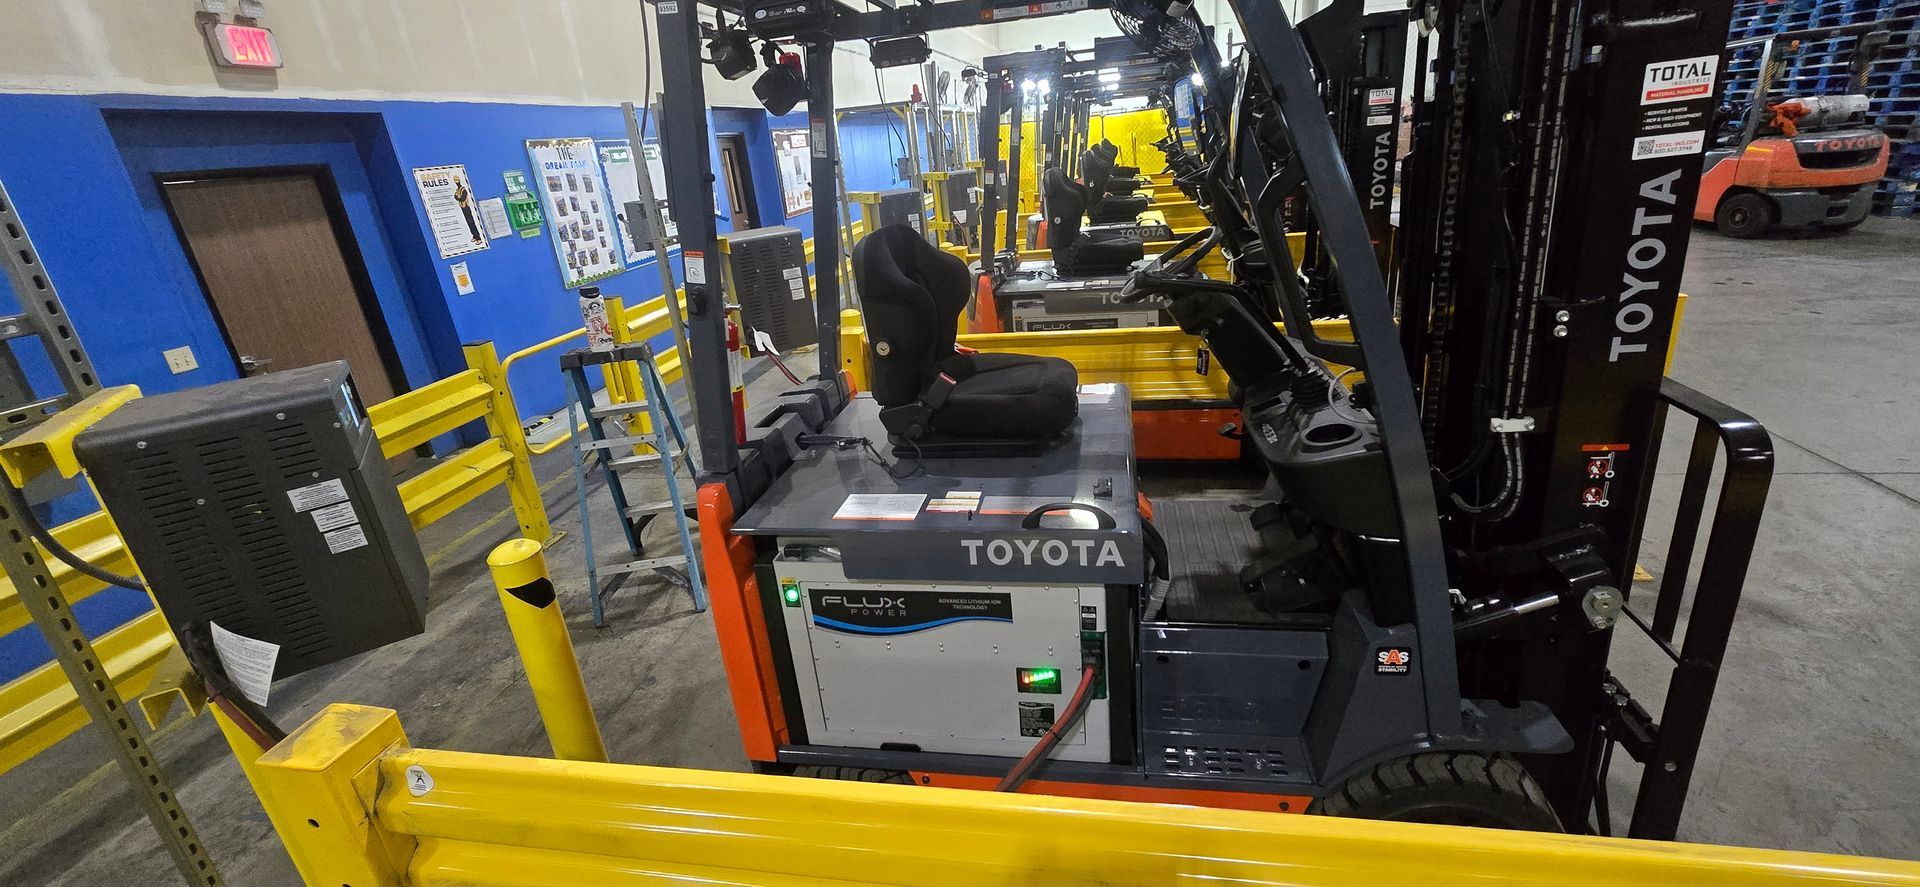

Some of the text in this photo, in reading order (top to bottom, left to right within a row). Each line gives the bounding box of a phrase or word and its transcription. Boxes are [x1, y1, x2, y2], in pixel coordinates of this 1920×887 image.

[228, 28, 273, 62] EXIT
[1650, 61, 1711, 82] TOTAL
[556, 147, 573, 160] THE
[420, 171, 451, 181] SAFETY
[1369, 131, 1391, 210] TOYOTA
[422, 179, 449, 188] RULES
[1120, 227, 1165, 236] TOYOTA
[1609, 168, 1682, 362] TOYOTA
[961, 539, 1125, 567] TOYOTA
[822, 596, 905, 609] FLUX
[851, 608, 907, 617] POWER
[1378, 649, 1409, 665] SAS
